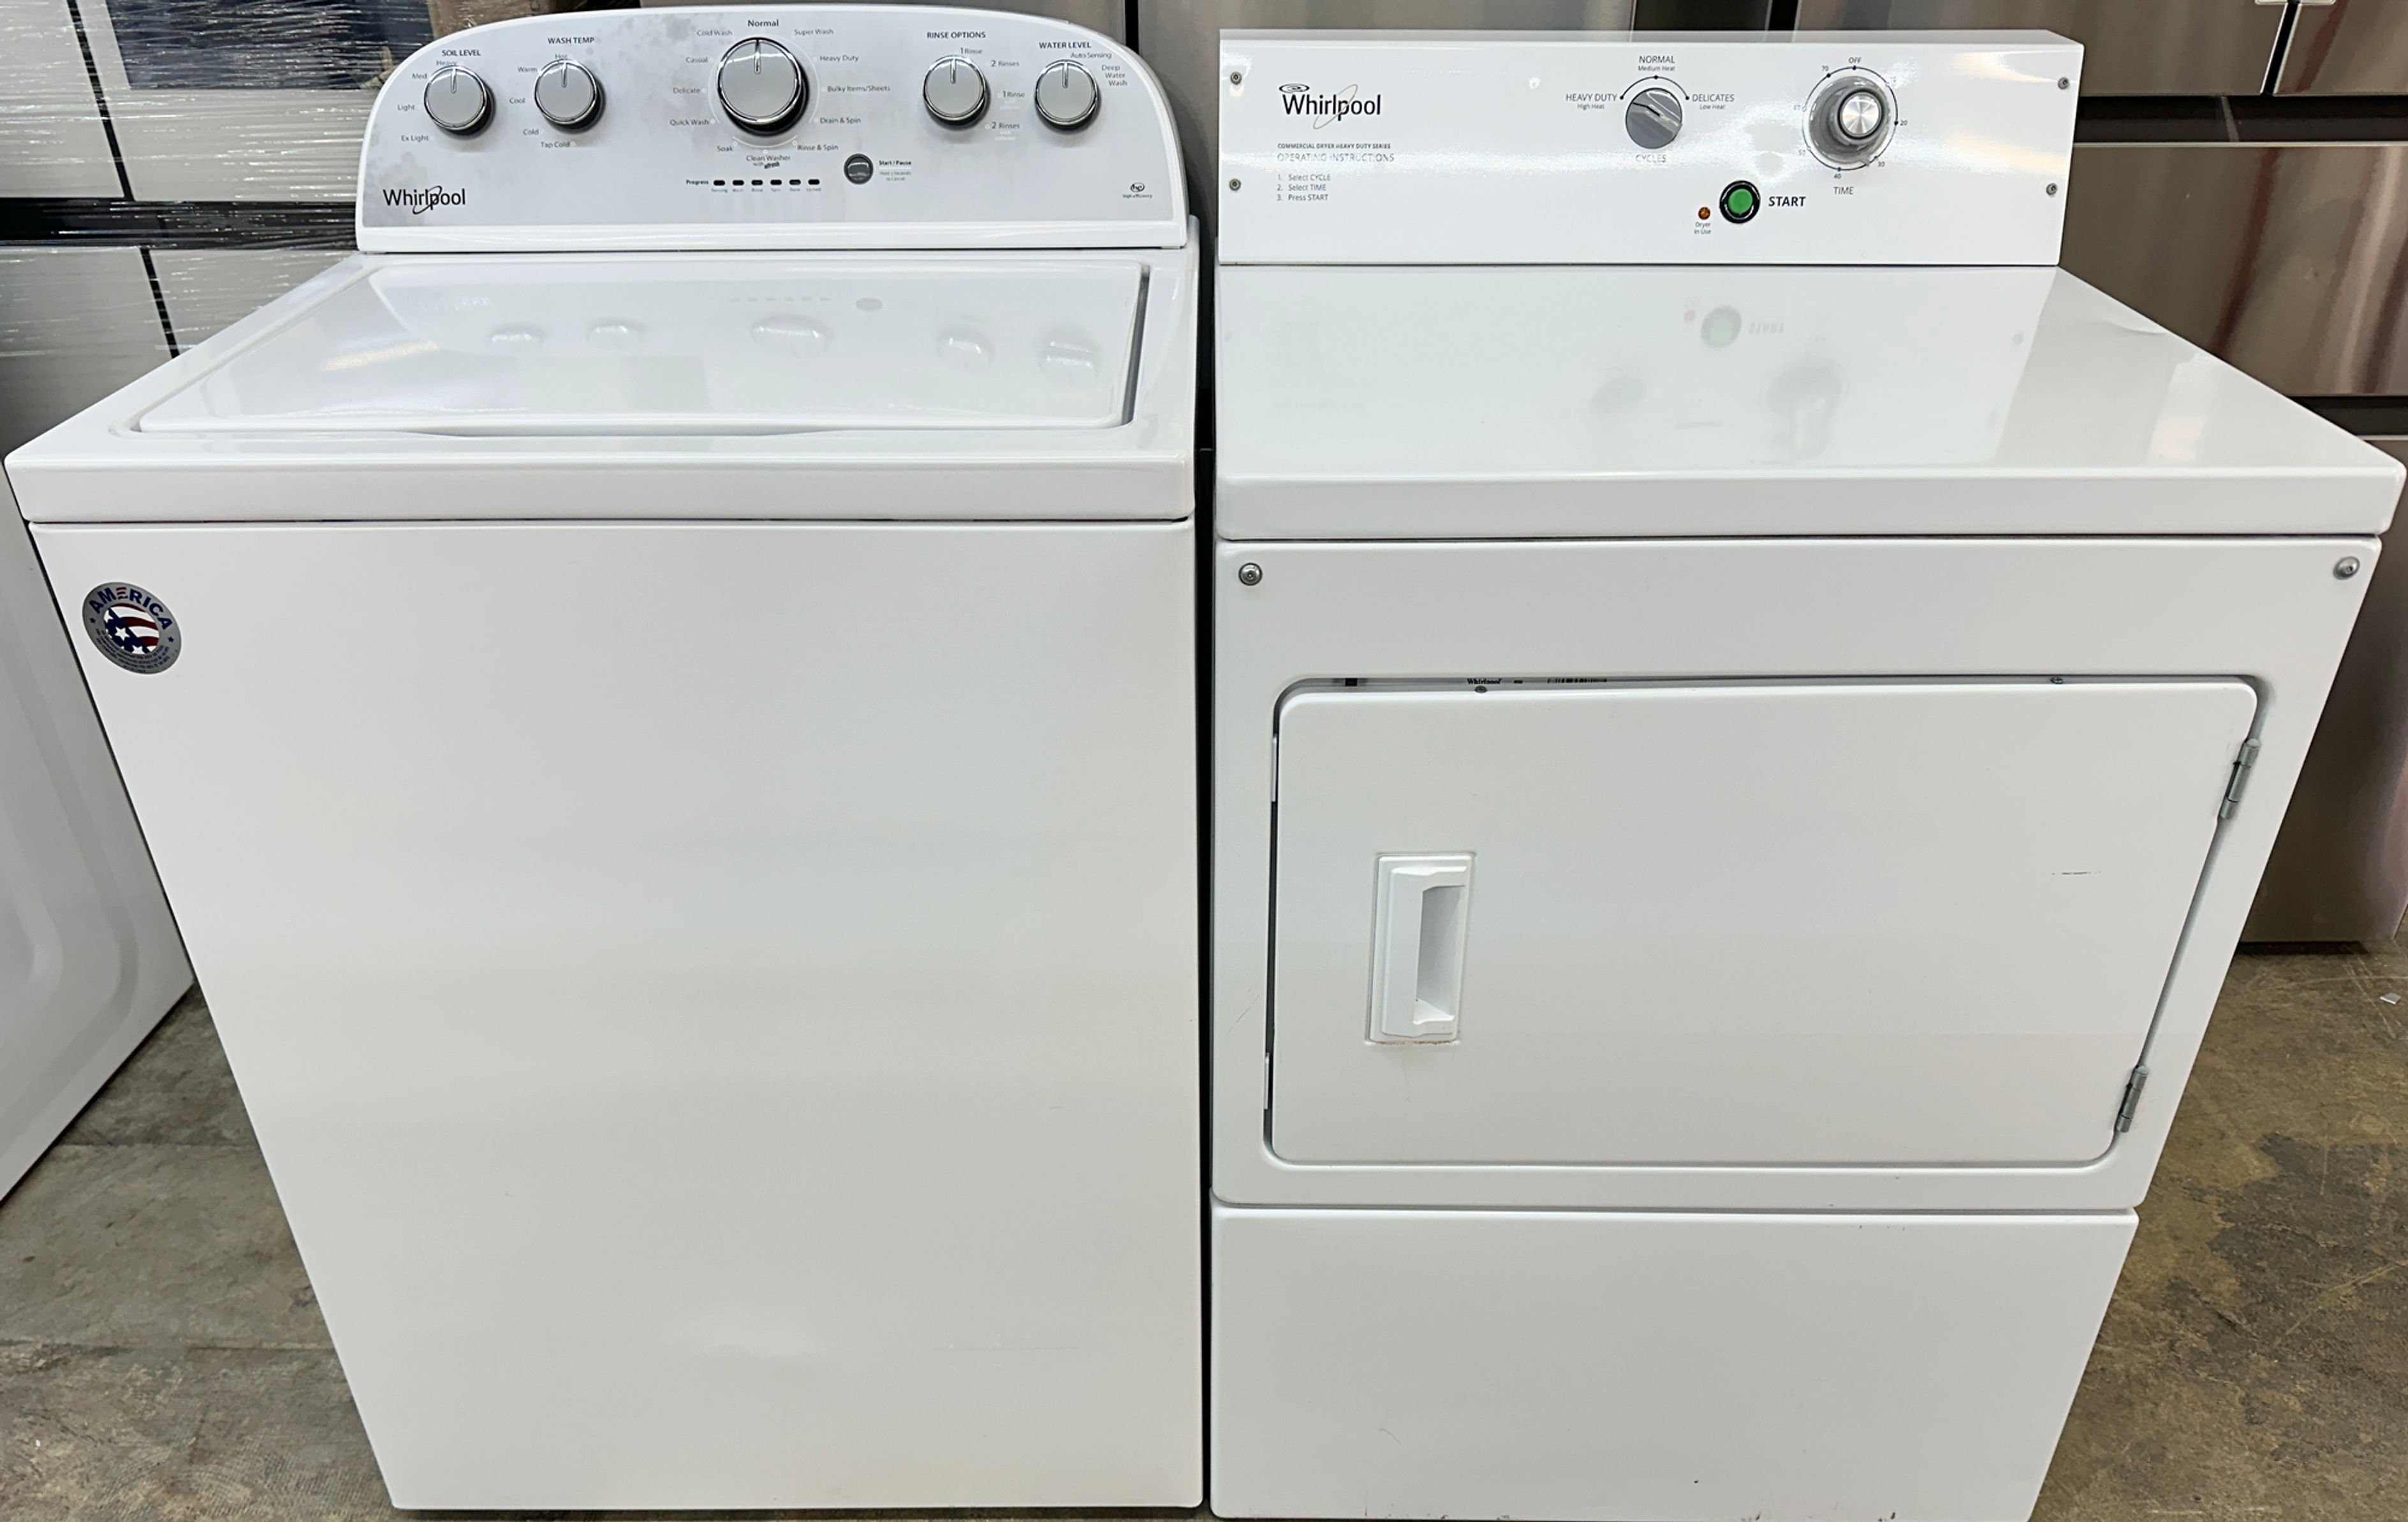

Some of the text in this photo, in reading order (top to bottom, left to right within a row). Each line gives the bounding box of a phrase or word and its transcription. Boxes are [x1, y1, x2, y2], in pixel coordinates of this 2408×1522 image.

[1282, 93, 1381, 122] Whirlpool
[1692, 94, 1735, 102] DELICATES
[1635, 154, 1667, 163] CYCLES
[383, 186, 466, 213] Whirlpool
[1768, 196, 1806, 207] START
[89, 587, 172, 630] AMERICA
